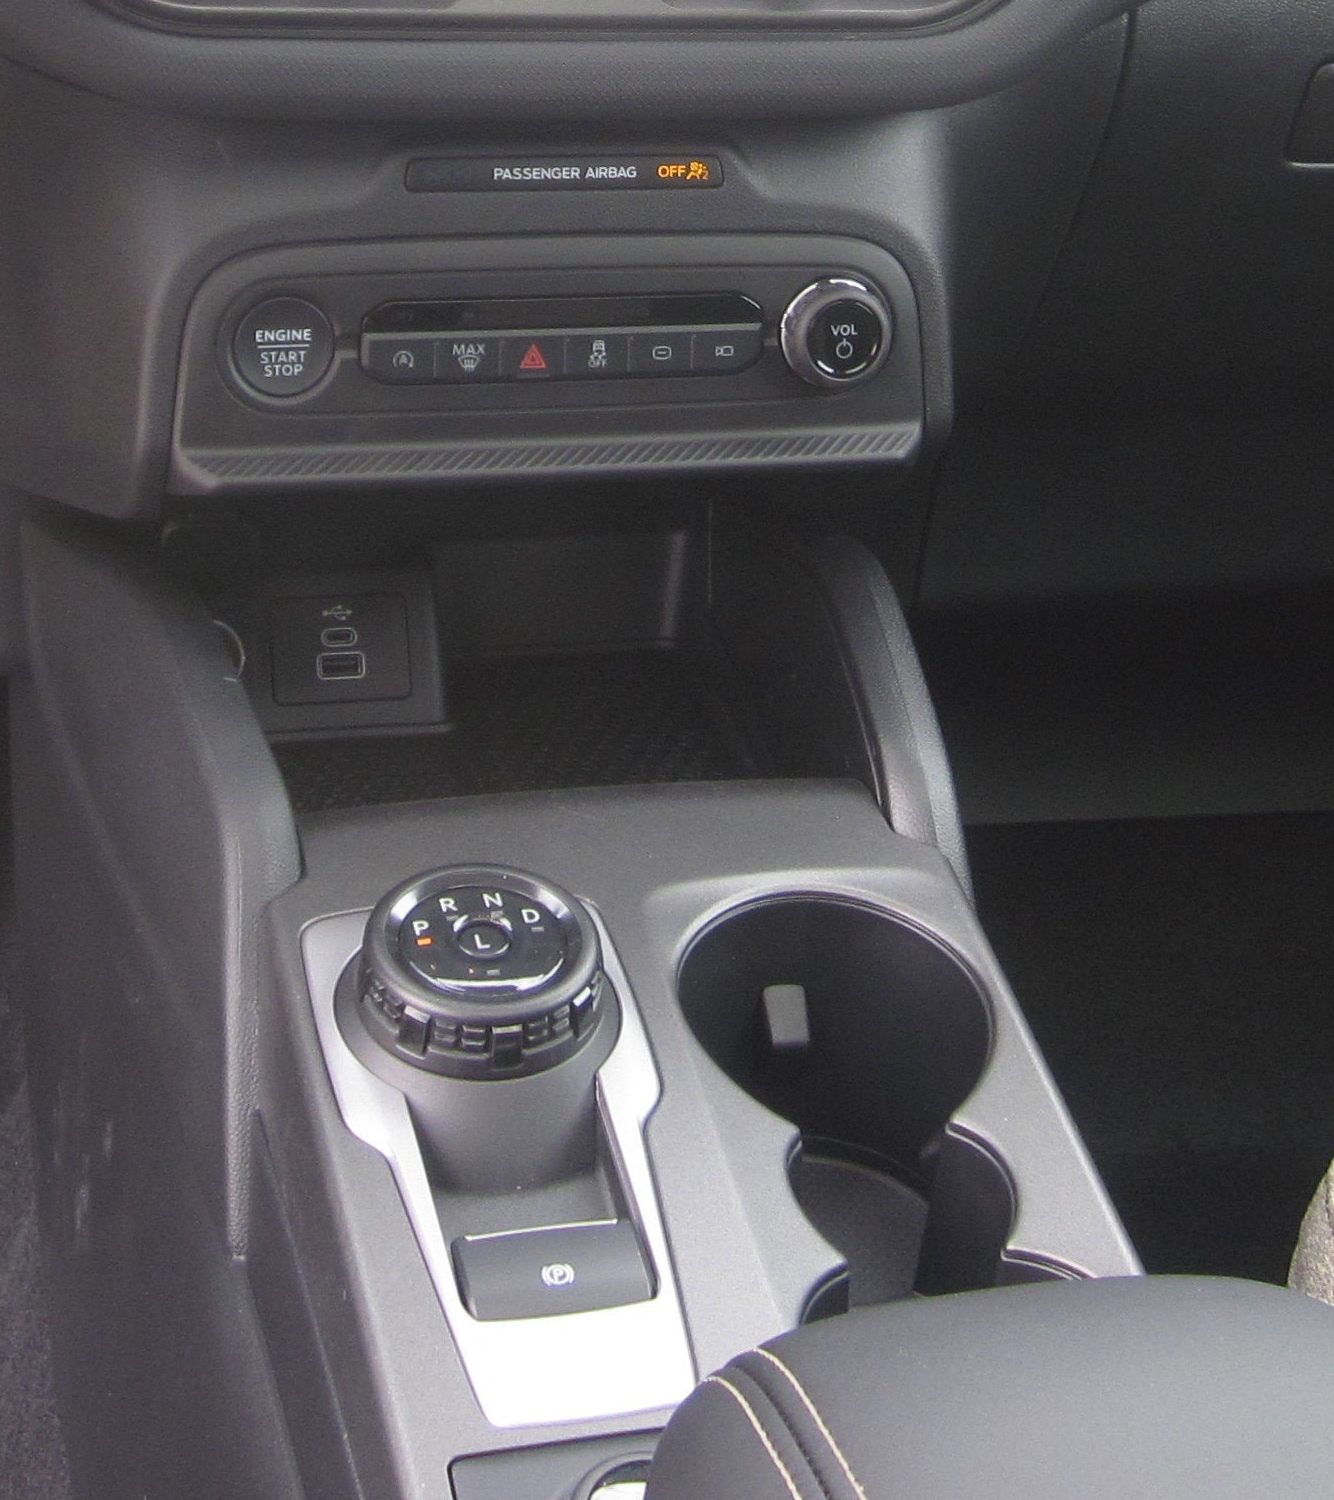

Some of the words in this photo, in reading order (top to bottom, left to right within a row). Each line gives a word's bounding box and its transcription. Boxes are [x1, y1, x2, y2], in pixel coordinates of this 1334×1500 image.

[493, 167, 581, 181] PASSENGER
[585, 166, 637, 179] AIRBAG
[657, 165, 685, 178] OFF
[255, 328, 312, 342] ENGINE
[831, 324, 858, 338] VOL
[452, 344, 485, 356] MAX
[260, 351, 306, 364] START
[588, 360, 607, 369] OFF
[264, 363, 303, 377] STOP
[413, 920, 429, 936] P
[439, 897, 454, 913] R
[484, 893, 502, 909] N
[523, 908, 539, 925] D
[475, 934, 489, 949] L
